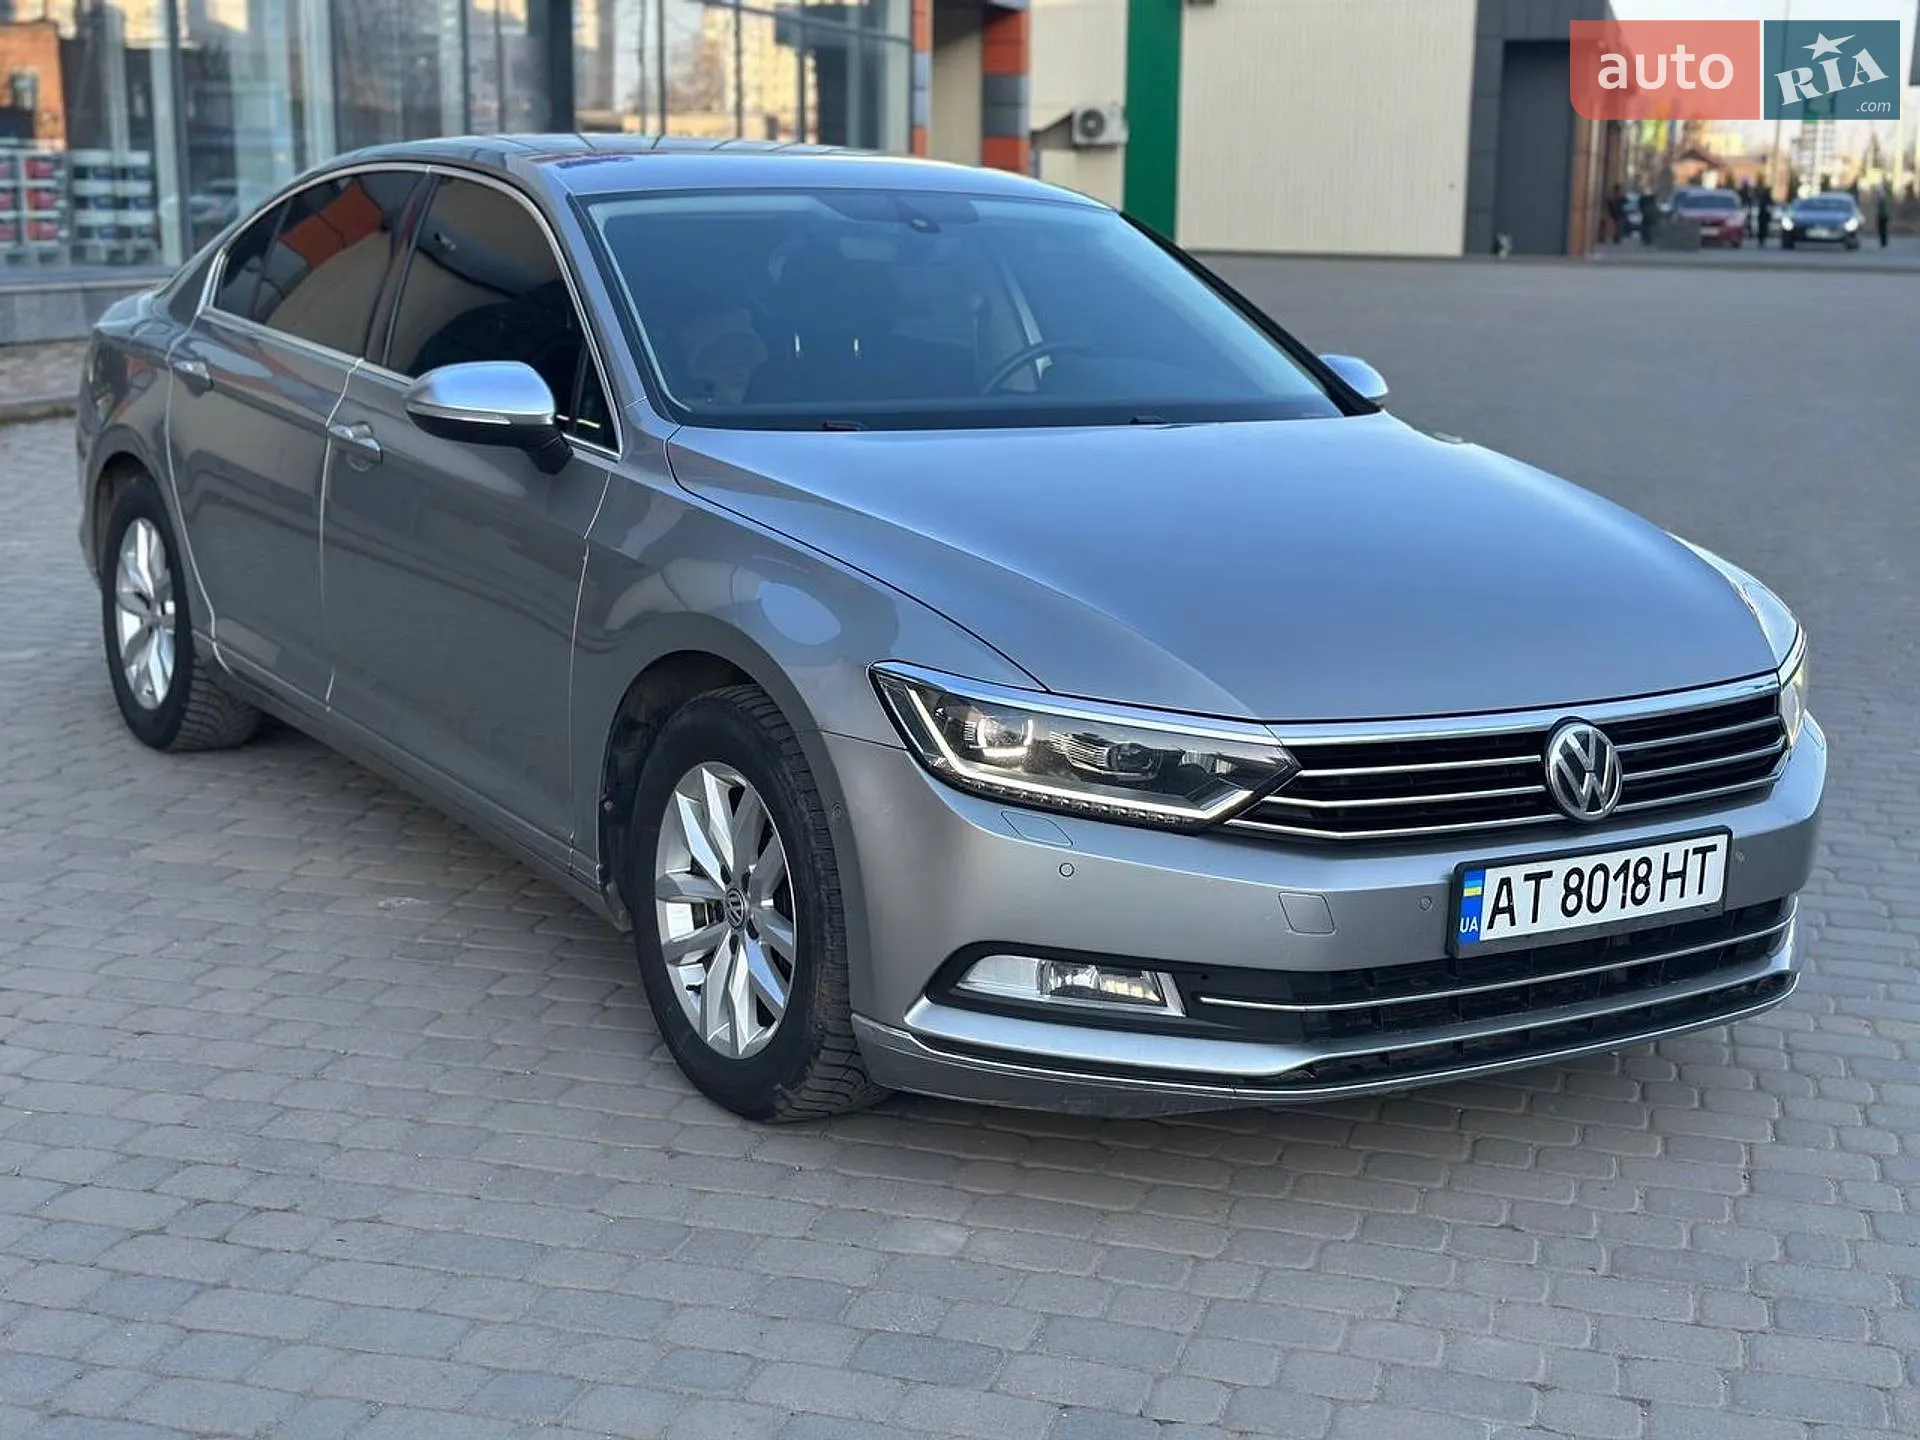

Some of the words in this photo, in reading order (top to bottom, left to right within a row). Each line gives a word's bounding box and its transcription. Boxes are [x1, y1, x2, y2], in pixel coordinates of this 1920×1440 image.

[1487, 870, 1553, 930] AT
[1561, 856, 1652, 918] 8018
[1659, 844, 1717, 902] HT
[1459, 916, 1479, 933] UA
